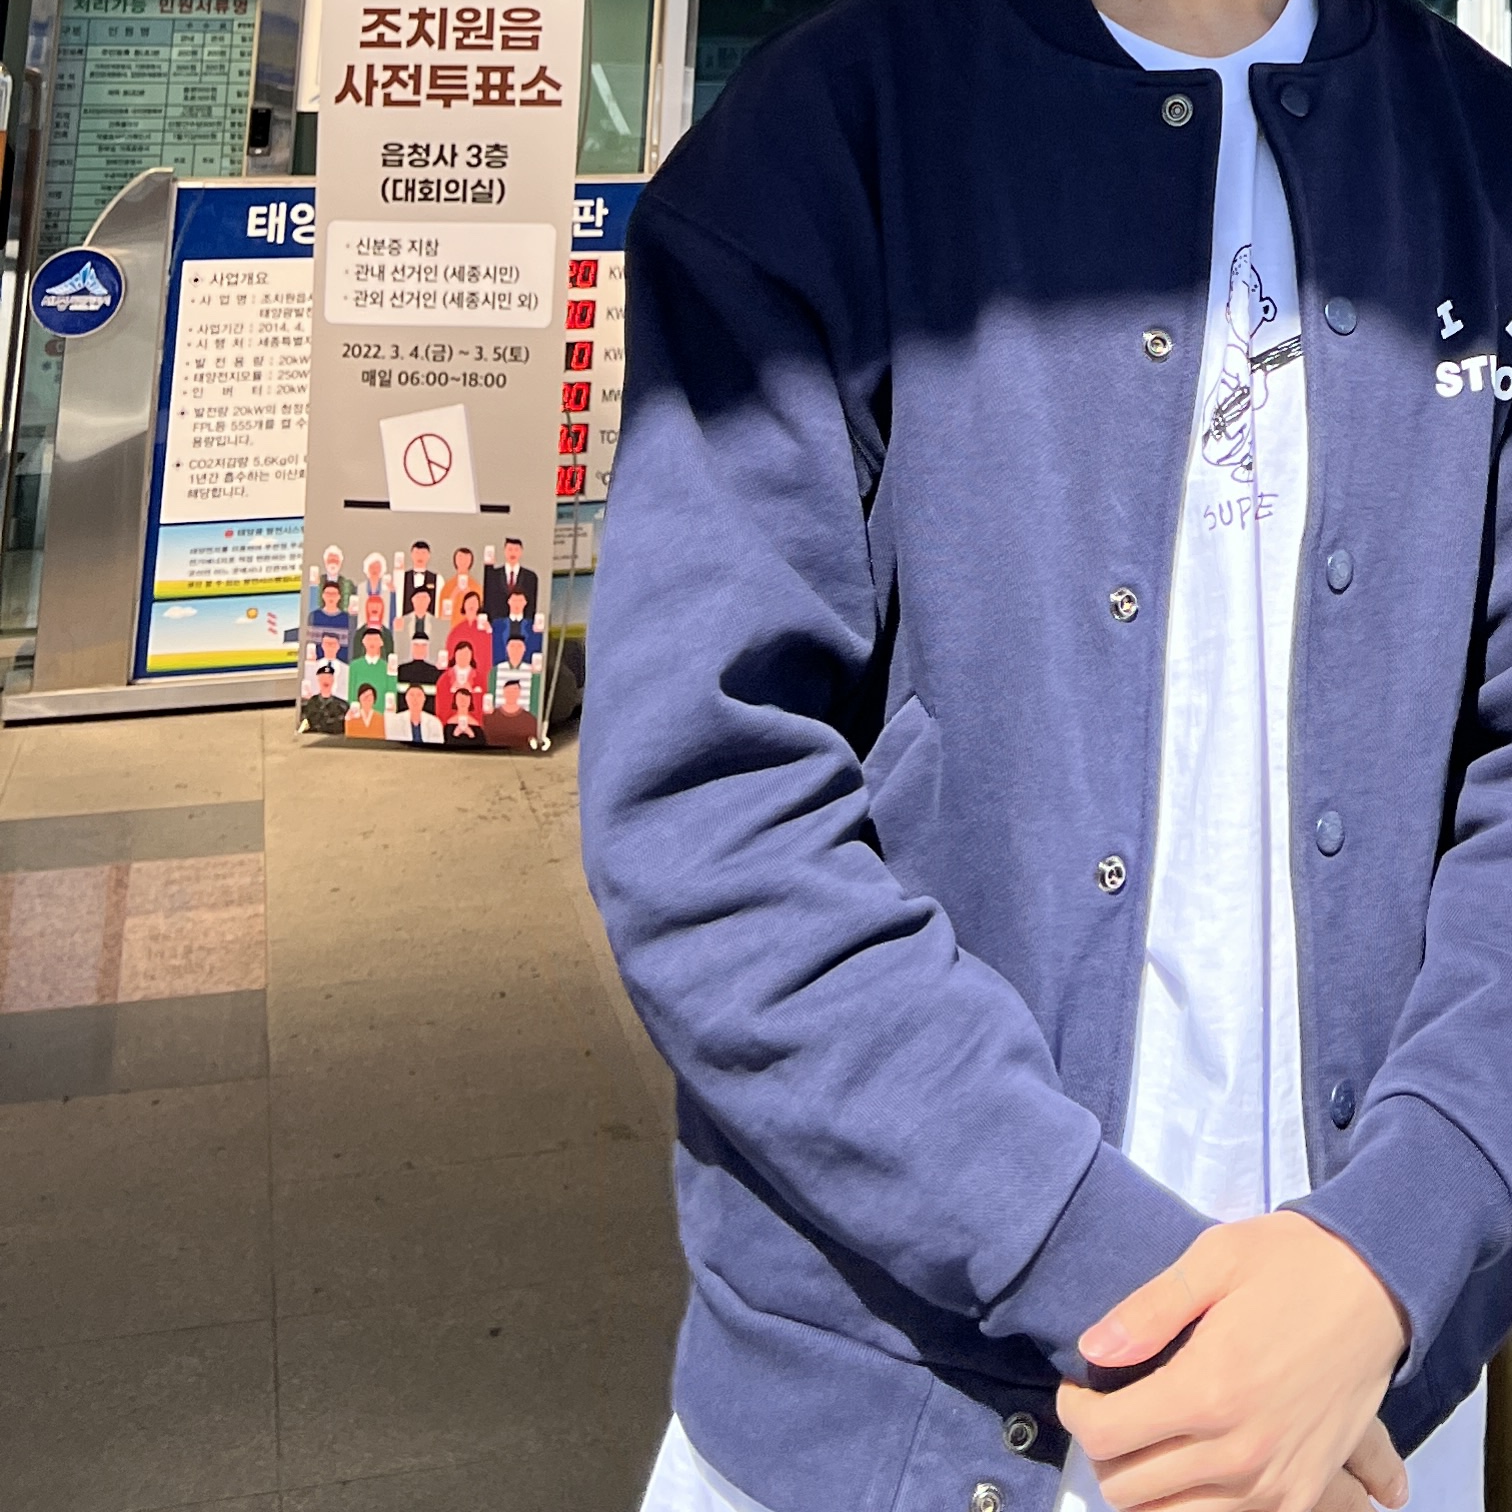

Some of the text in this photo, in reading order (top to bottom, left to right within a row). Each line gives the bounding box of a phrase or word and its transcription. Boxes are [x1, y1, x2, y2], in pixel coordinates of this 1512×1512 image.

[359, 7, 543, 51] 조치원읍
[334, 63, 563, 109] 사전투표소
[380, 142, 510, 169] 읍청사 3층
[380, 177, 506, 204] (대회의실)
[355, 238, 403, 257] 신분증
[210, 272, 269, 286] 사업개요
[354, 264, 520, 285] 관내 선거인 (세종시민)
[353, 290, 539, 311] 관외 선거인 (세종시민 외)
[1436, 300, 1464, 340] I
[342, 343, 386, 359] 2022.
[390, 344, 404, 360] 3.
[474, 346, 488, 361] 3.
[492, 345, 531, 364] 5(토)
[361, 370, 508, 389] 매일 06:00~18:00
